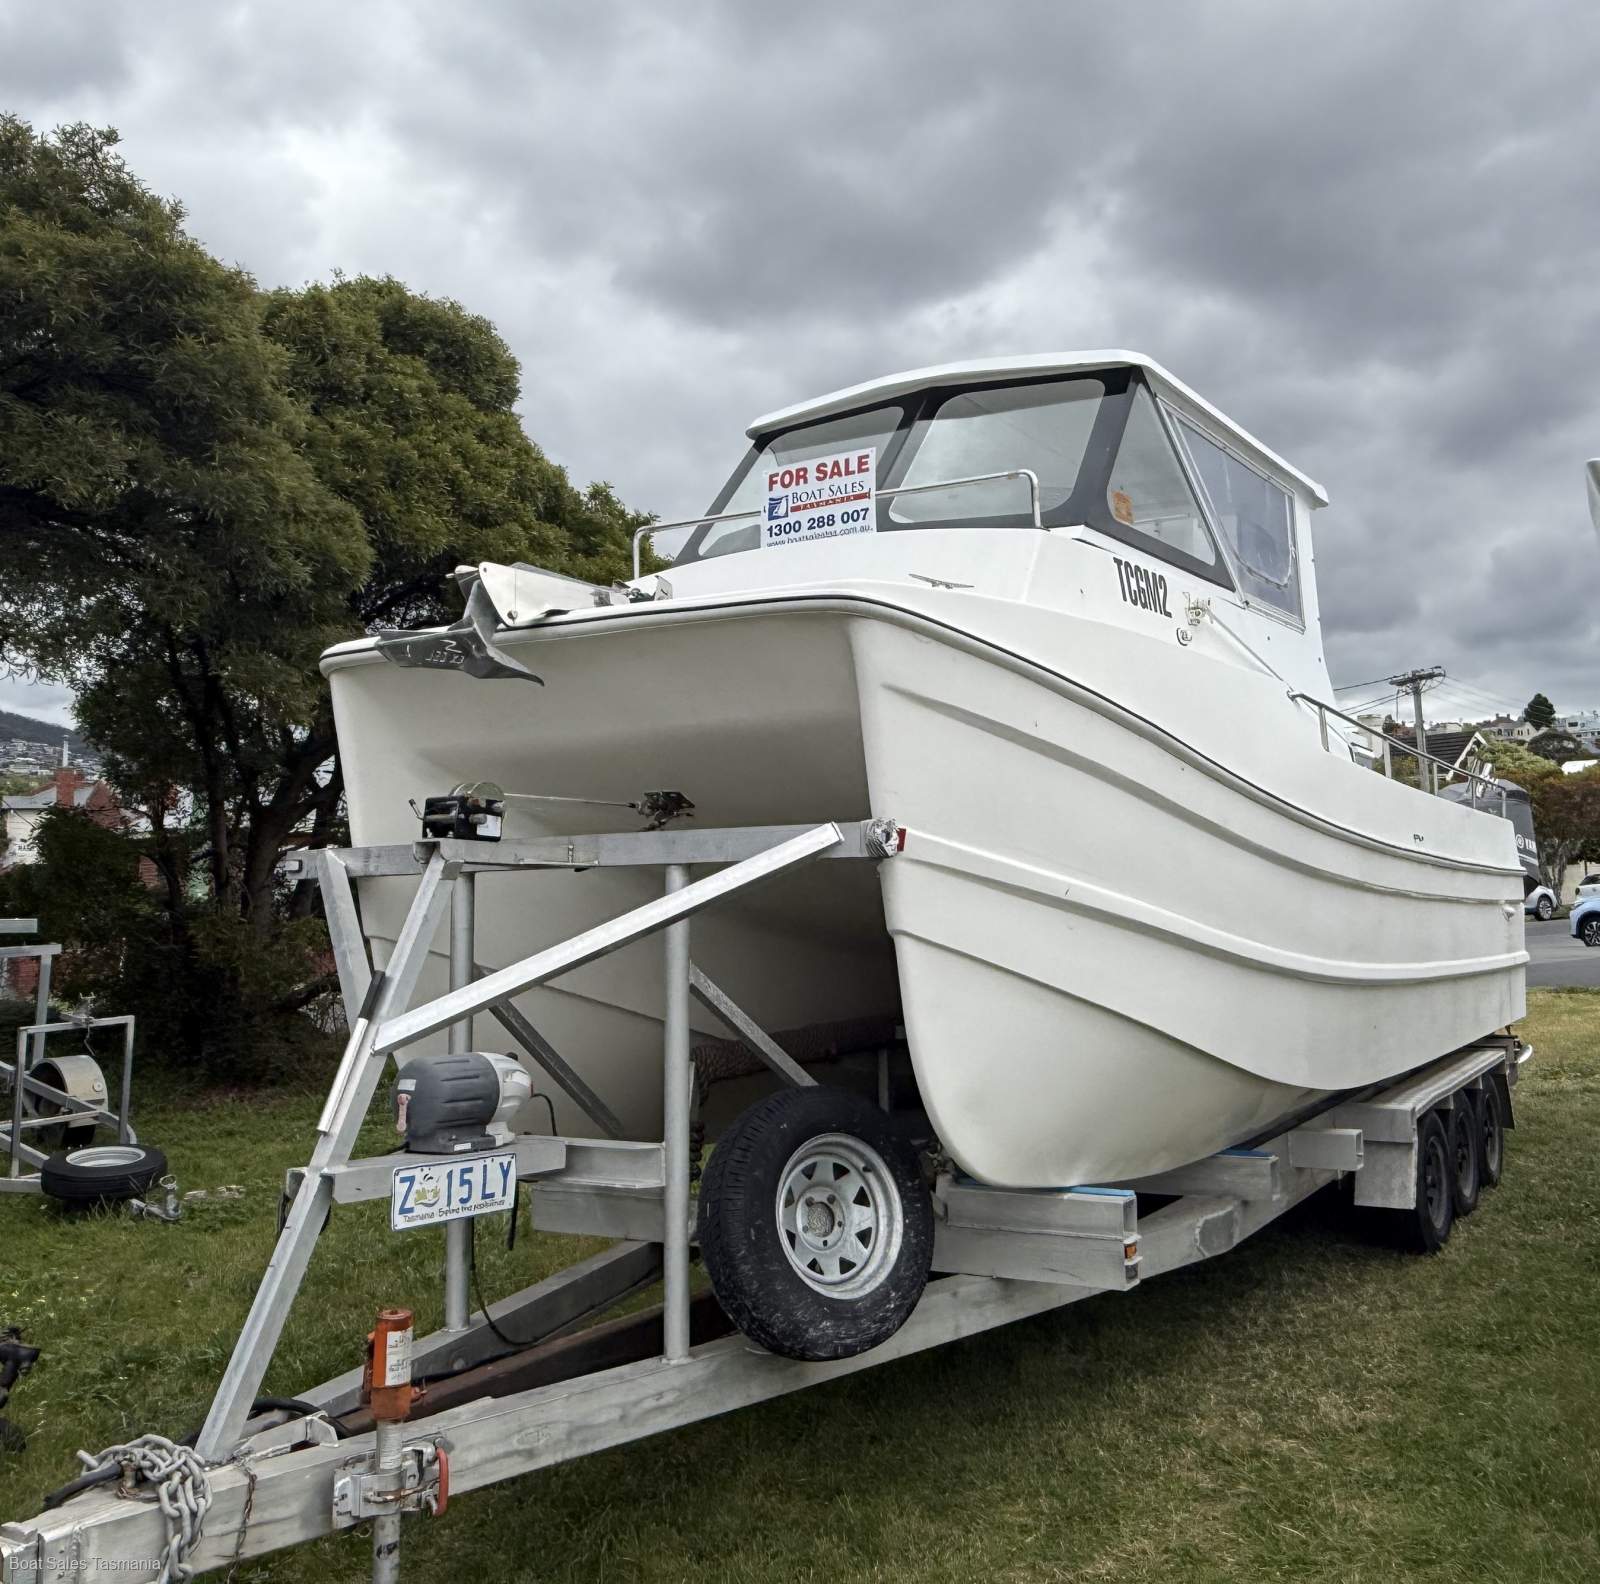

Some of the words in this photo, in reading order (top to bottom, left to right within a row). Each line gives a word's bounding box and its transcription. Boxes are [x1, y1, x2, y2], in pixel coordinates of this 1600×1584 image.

[768, 467, 808, 492] FOR
[815, 454, 870, 482] SALE
[767, 520, 801, 538] 1300
[807, 514, 836, 531] 288
[840, 508, 869, 524] 007
[1112, 556, 1173, 619] TCGM2
